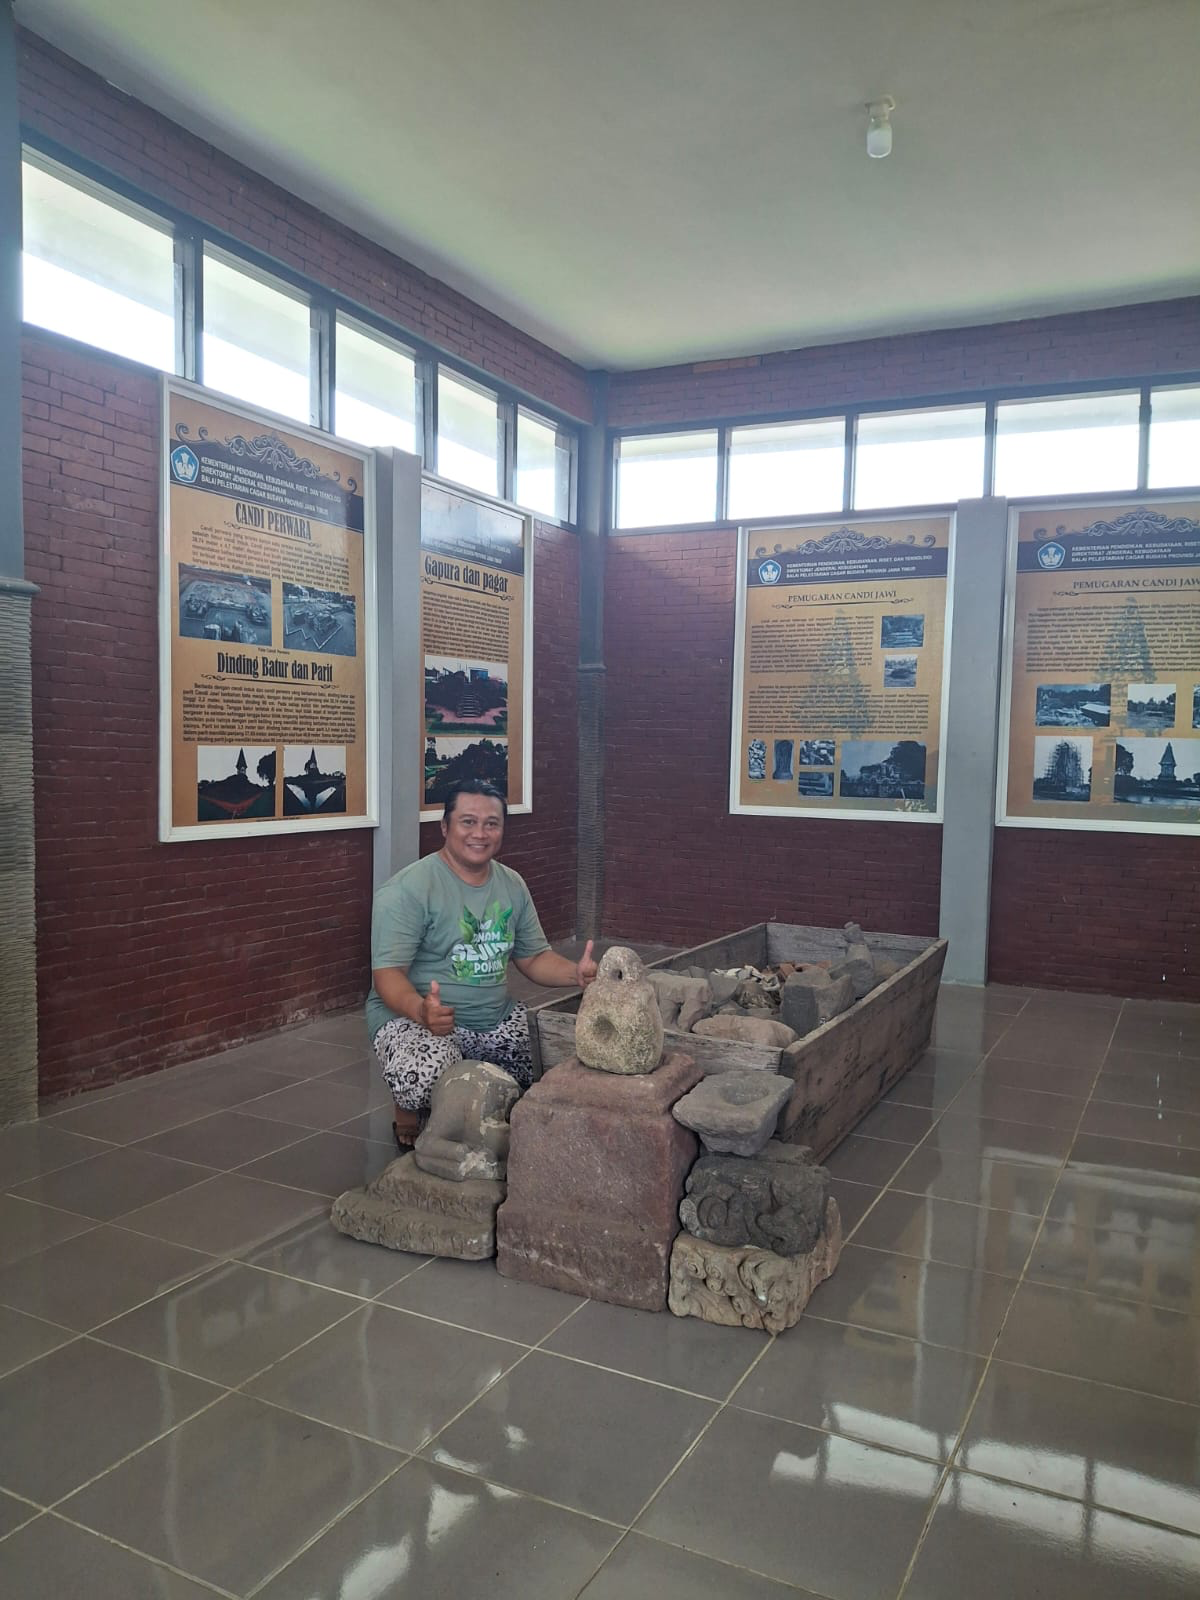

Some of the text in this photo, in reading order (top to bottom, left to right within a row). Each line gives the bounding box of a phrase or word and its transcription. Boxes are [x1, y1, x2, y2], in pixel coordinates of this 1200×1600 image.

[201, 466, 231, 481] DIREKTORAT
[232, 474, 256, 487] JENDERAL
[201, 474, 217, 486] BALAI
[236, 502, 312, 540] CANDI PERWARA
[425, 555, 508, 593] Gapura dan pagar
[1074, 577, 1200, 589] PEMUGARAN CANDI JAW
[788, 590, 897, 602] PEMUGARAN CANDI JAWI
[217, 652, 333, 682] Dinding Batur dan Parit
